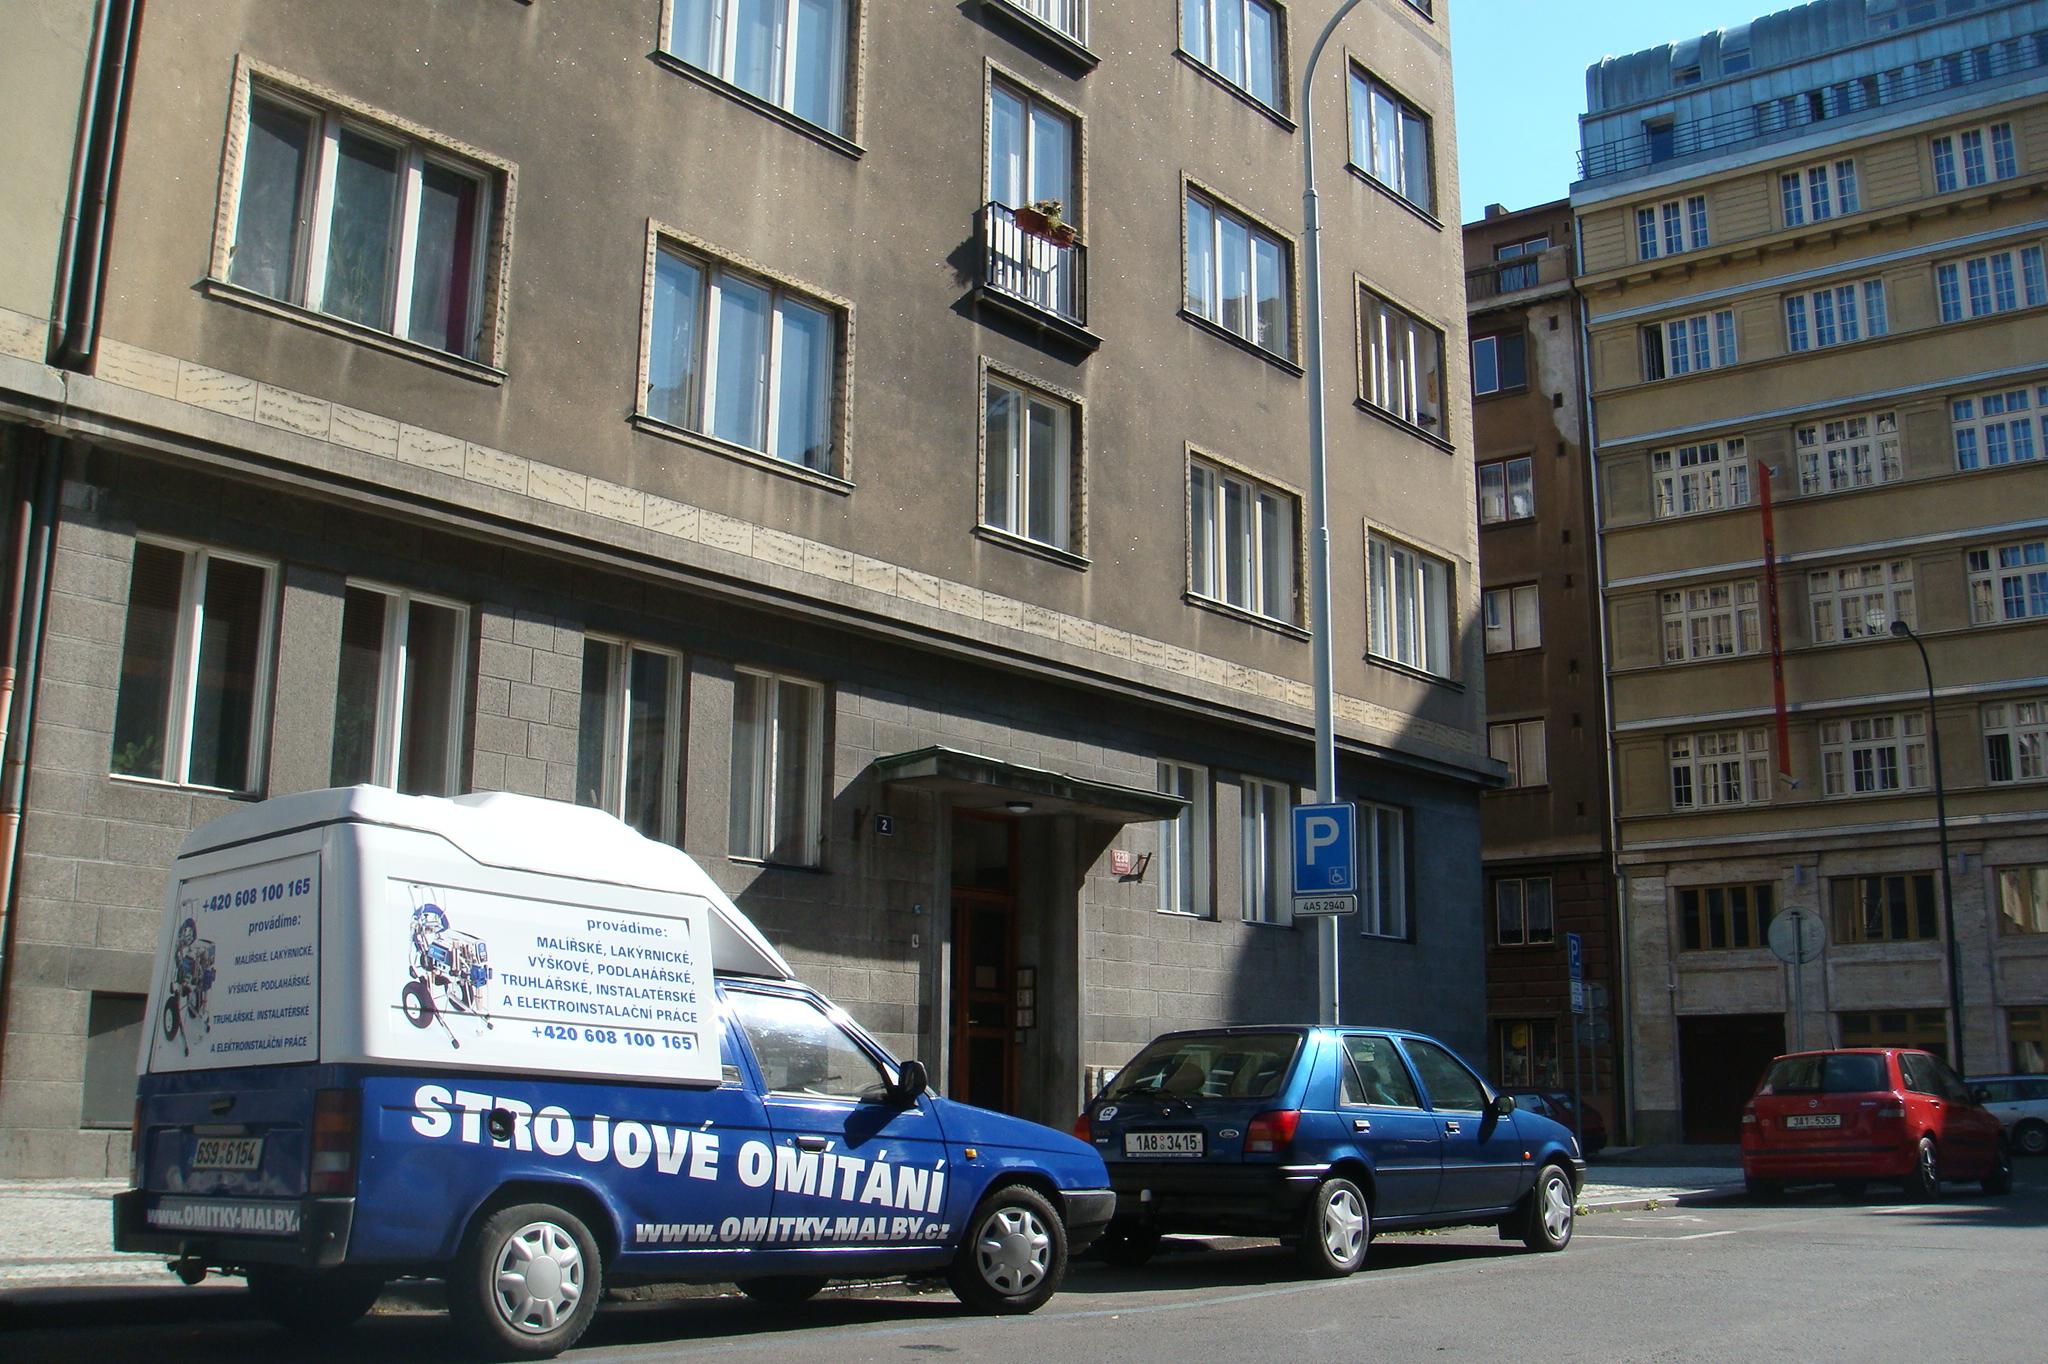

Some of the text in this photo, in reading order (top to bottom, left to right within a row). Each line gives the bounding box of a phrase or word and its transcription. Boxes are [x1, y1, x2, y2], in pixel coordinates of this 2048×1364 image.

[881, 820, 888, 831] 2
[1306, 816, 1339, 865] P
[203, 877, 310, 912] +420 608 100 165
[1323, 900, 1345, 910] 2940
[537, 936, 694, 966] MALÍŘSKÉ, LAKÝRNICKÉ,
[528, 953, 695, 985] VÝŠKOVÉ, PODLAHÁŘSKÉ,
[501, 973, 696, 1004] TRUHLÁŘSKÉ, INSTALATÉRSKÉ
[503, 995, 698, 1023] A ELEKTROINSTALAČNÍ PRÁCE
[210, 1044, 216, 1053] A
[284, 1035, 307, 1048] PRÁCE
[532, 1025, 692, 1050] +420 608 100 165
[225, 1140, 257, 1165] 6154
[411, 1084, 946, 1214] STROJOVÉ OMÍTÁNÍ
[1136, 1135, 1197, 1150] 1A8 3415
[635, 1216, 951, 1243] www.OMITKY-MALBY.cz
